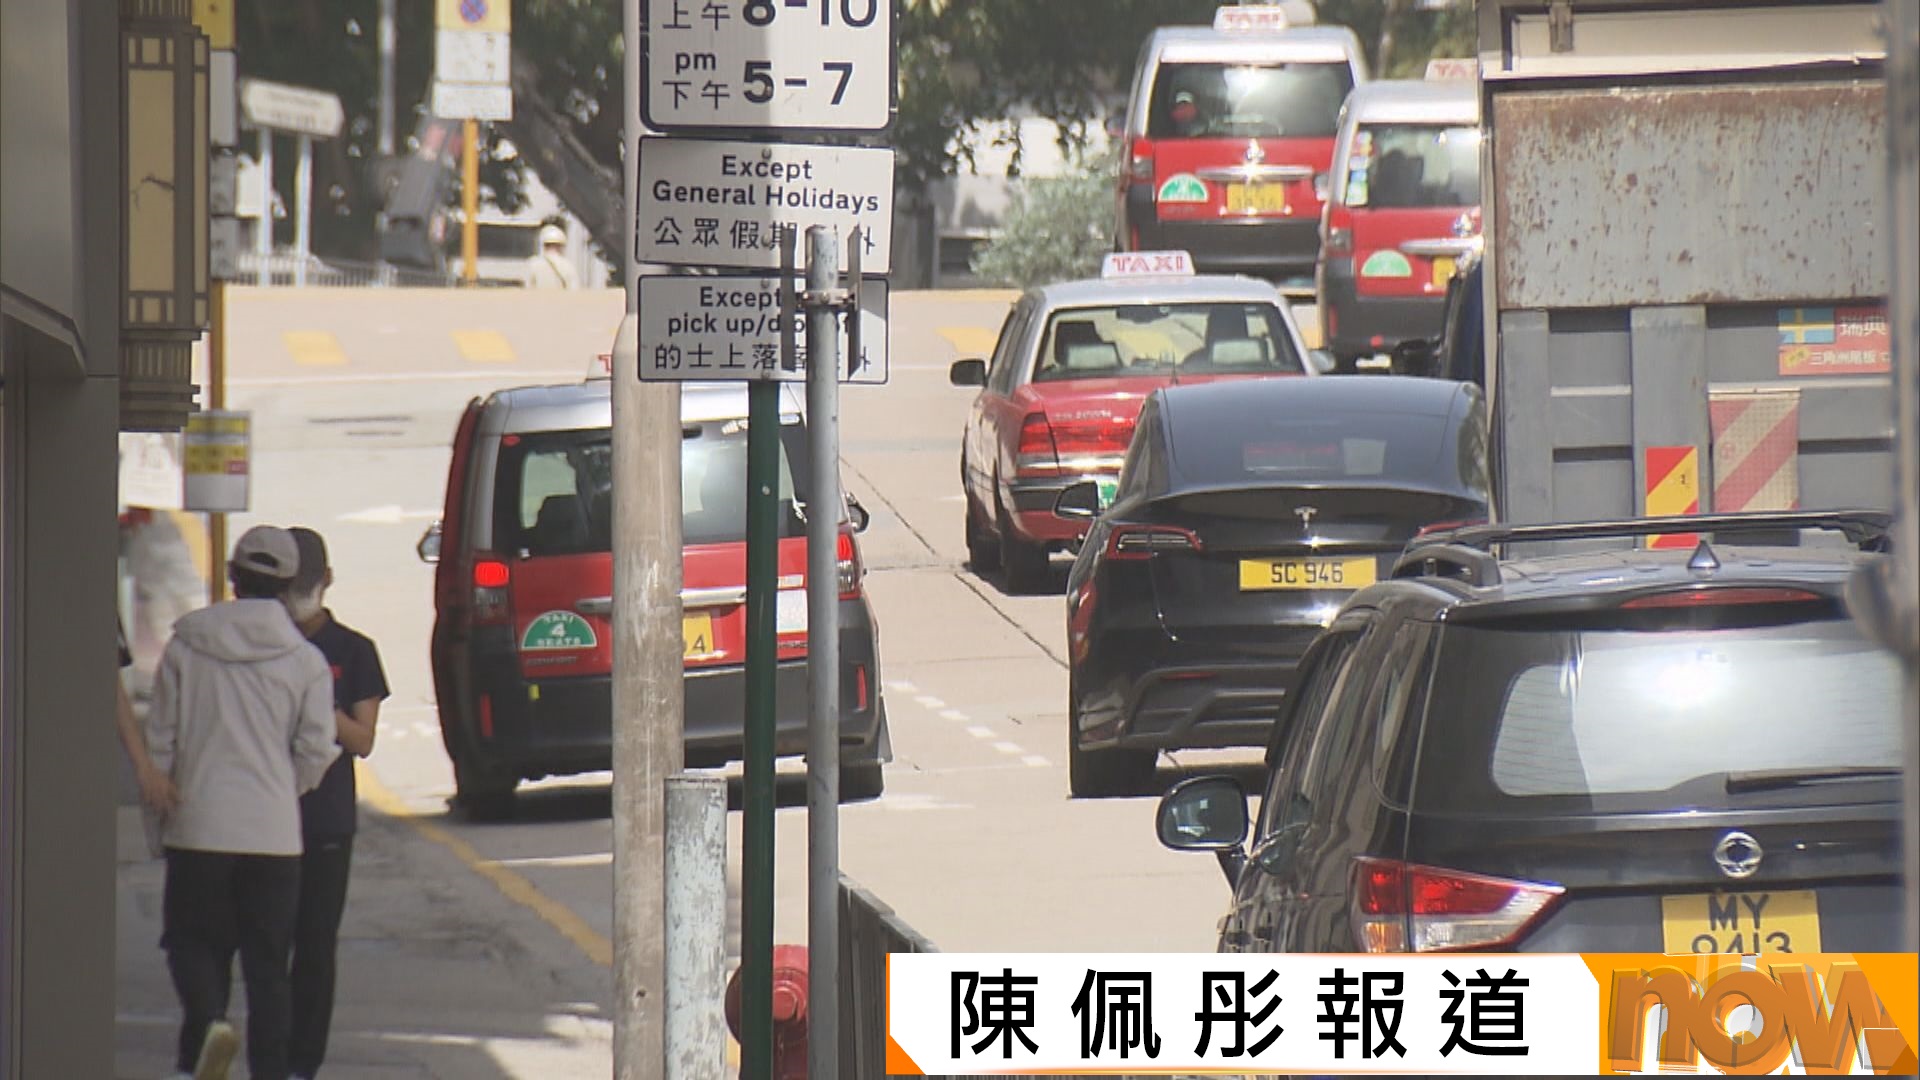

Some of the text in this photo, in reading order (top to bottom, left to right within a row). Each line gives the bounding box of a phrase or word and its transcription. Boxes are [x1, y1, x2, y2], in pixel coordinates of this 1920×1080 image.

[662, 0, 730, 30] 上午
[1223, 13, 1279, 23] TAXI
[675, 52, 716, 75] pm
[662, 80, 730, 109] 下午
[721, 155, 812, 182] Except
[653, 180, 878, 215] General Holidays
[1112, 255, 1184, 272] TAXI
[668, 312, 717, 337] pick
[1271, 561, 1343, 584] SC 946
[543, 614, 574, 624] TAXI
[551, 622, 566, 638] 4
[536, 637, 581, 646] SEATS
[1708, 893, 1769, 931] MY
